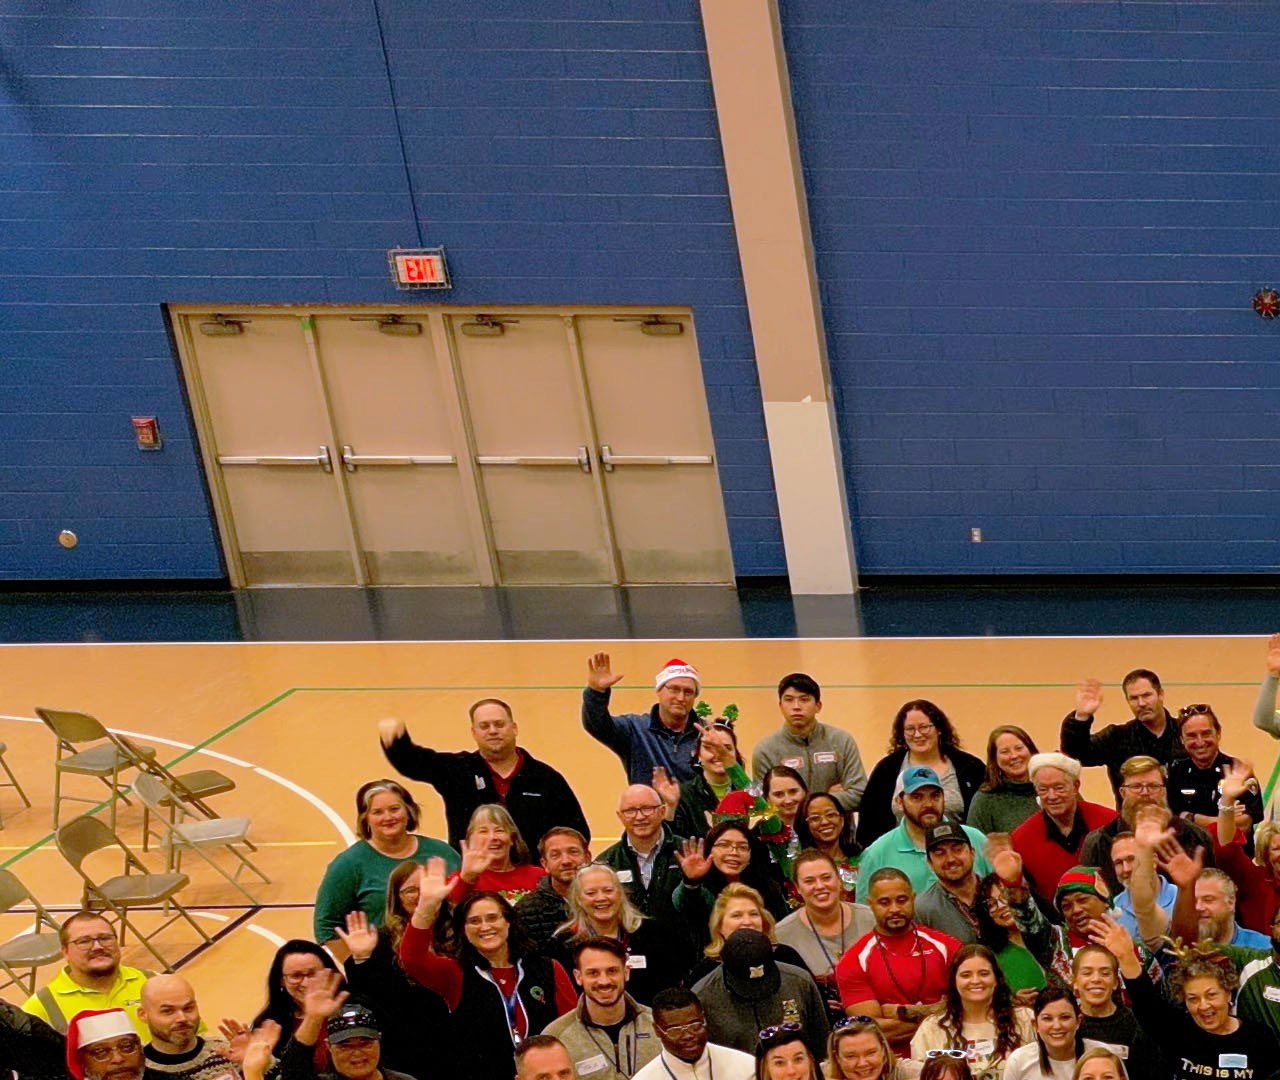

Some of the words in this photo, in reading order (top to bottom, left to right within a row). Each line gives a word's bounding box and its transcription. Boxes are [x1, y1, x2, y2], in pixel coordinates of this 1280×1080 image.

[404, 258, 436, 281] EXIT
[1181, 1058, 1213, 1076] THIS
[1216, 1069, 1230, 1078] IS
[1234, 1069, 1254, 1079] MY
